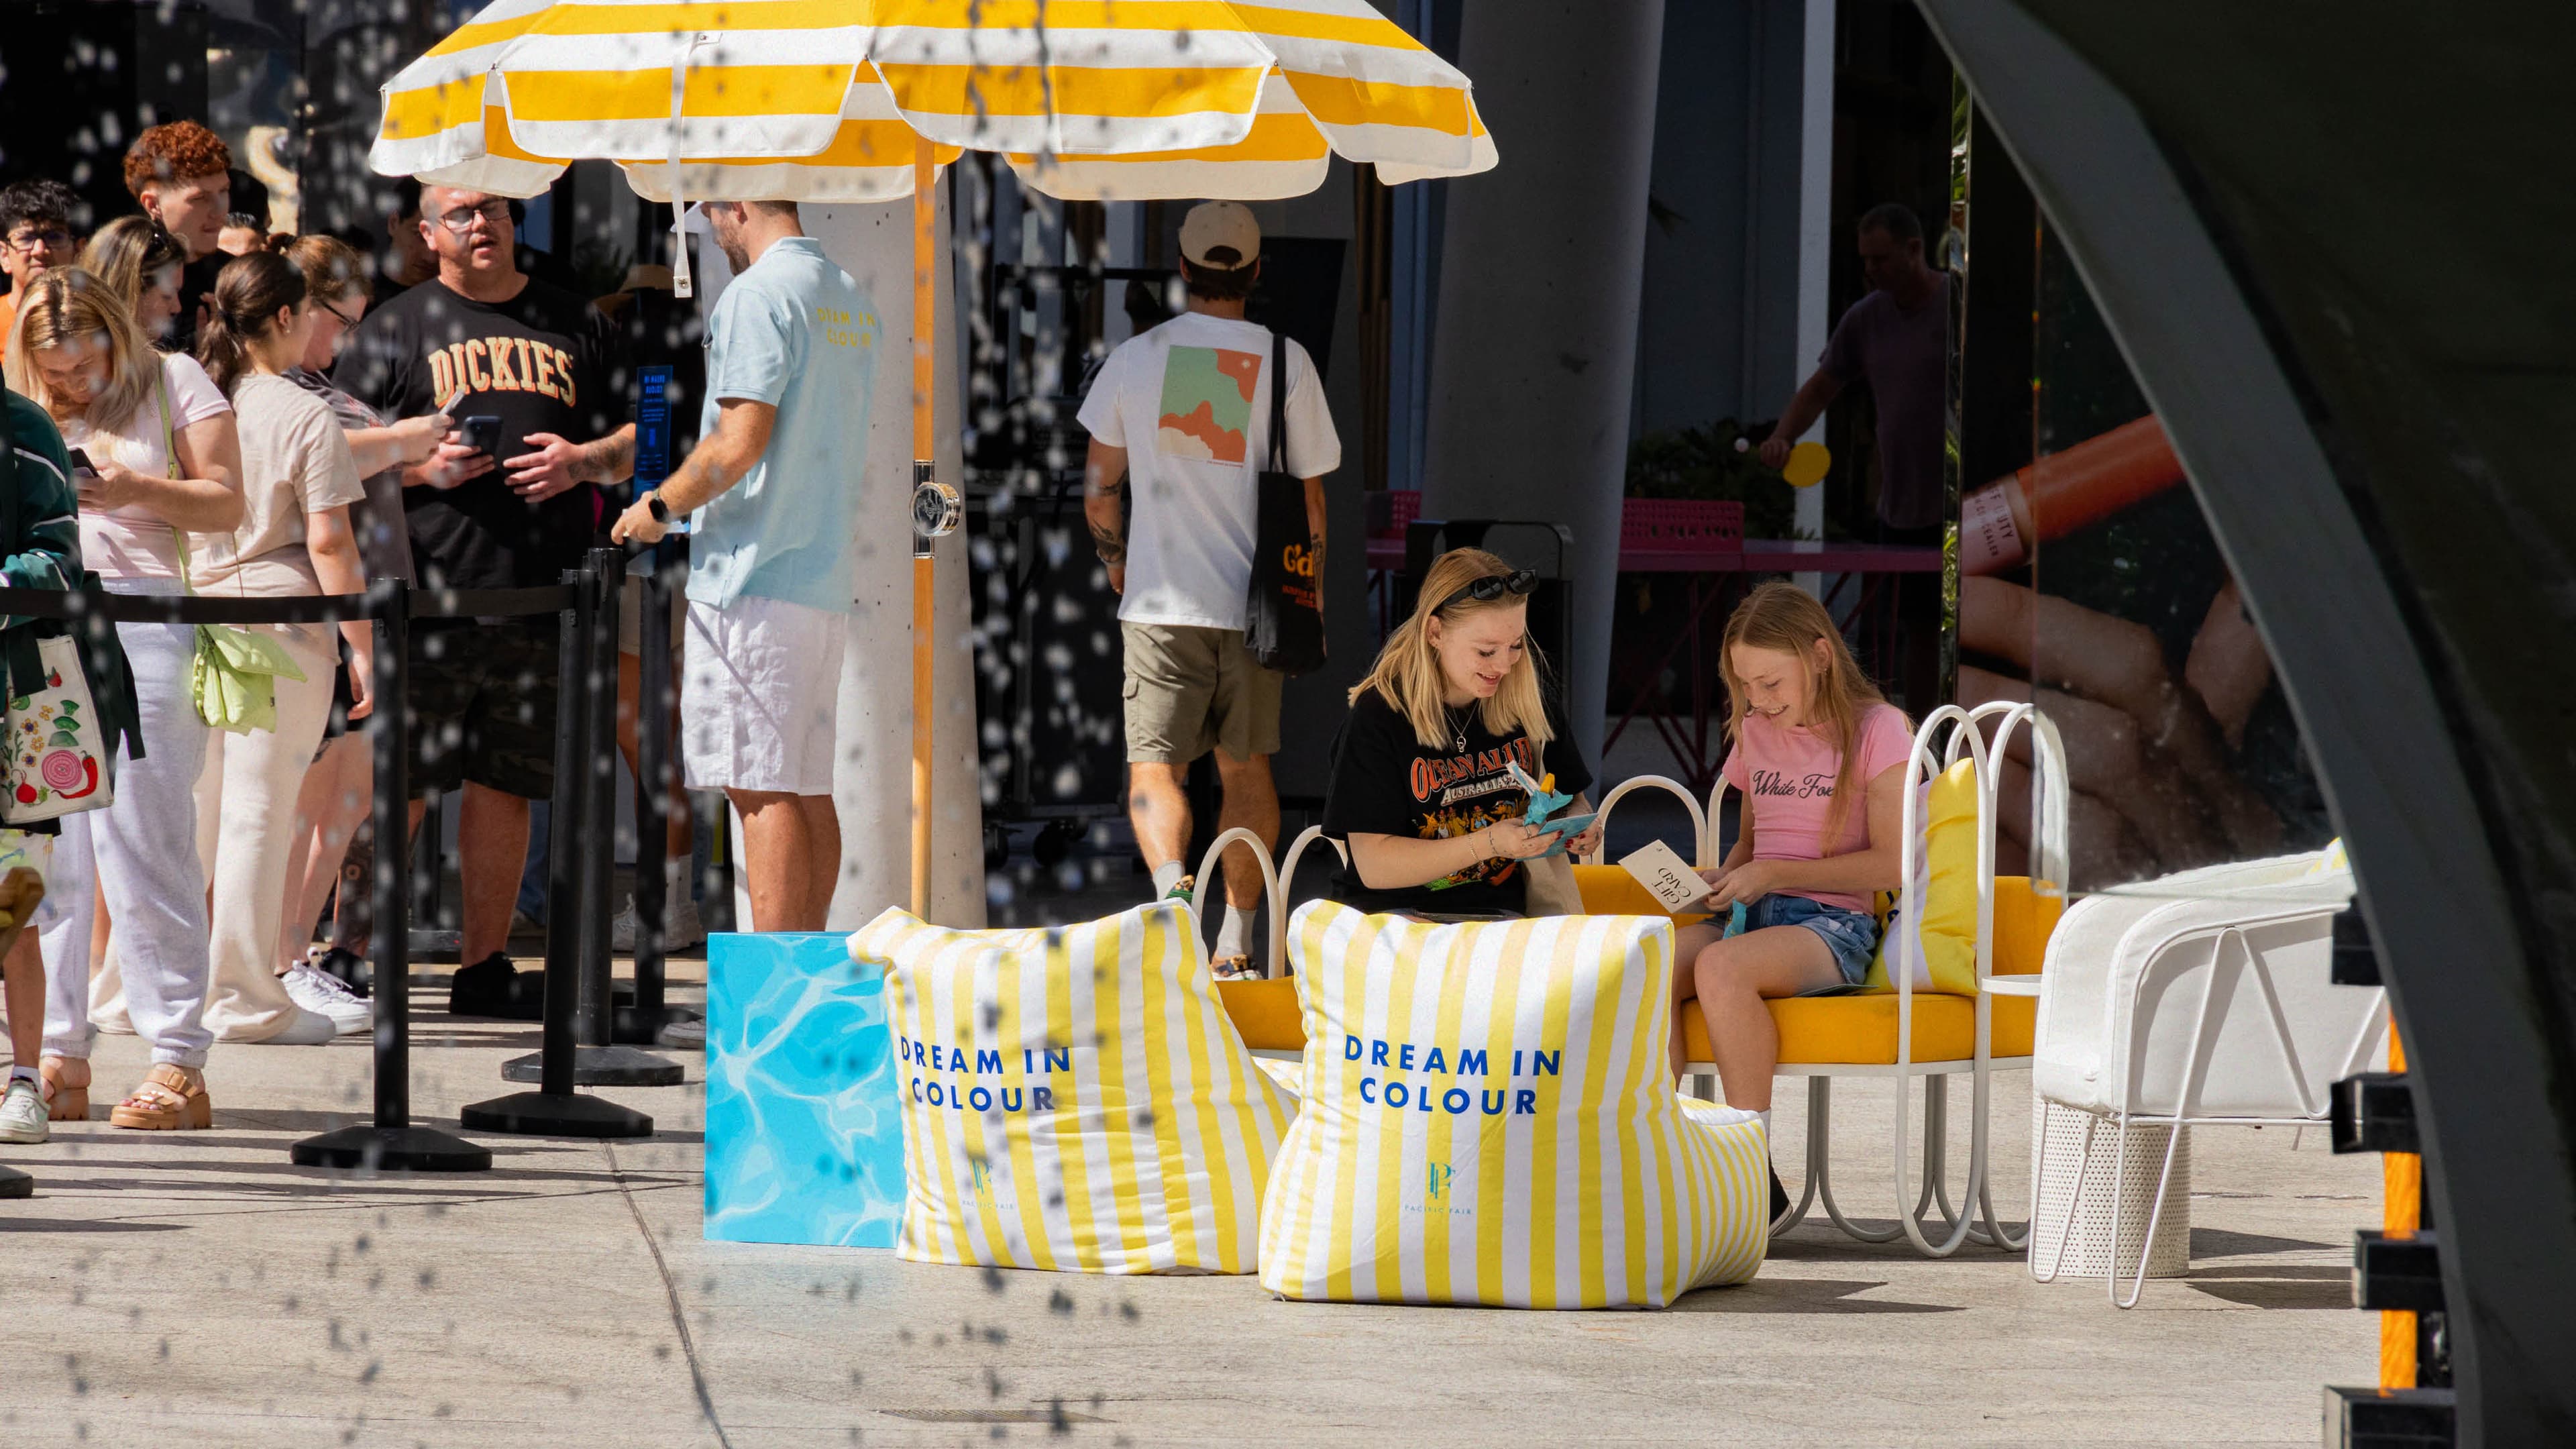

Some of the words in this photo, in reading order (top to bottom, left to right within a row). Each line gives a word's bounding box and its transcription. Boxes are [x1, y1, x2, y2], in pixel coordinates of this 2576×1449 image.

[428, 337, 576, 408] DICKIES
[1411, 753, 1475, 803] OCEAN
[1477, 737, 1534, 776] ALLE
[1753, 770, 1796, 796] White
[1651, 881, 1680, 904] GIFT
[1658, 867, 1691, 898] CARD
[900, 1035, 1004, 1075] DREAM
[1024, 1046, 1070, 1074] IN
[1344, 1034, 1489, 1076] DREAM
[1512, 1049, 1560, 1077] IN
[912, 1077, 1056, 1112] COLOUR
[1359, 1077, 1537, 1116] COLOUR
